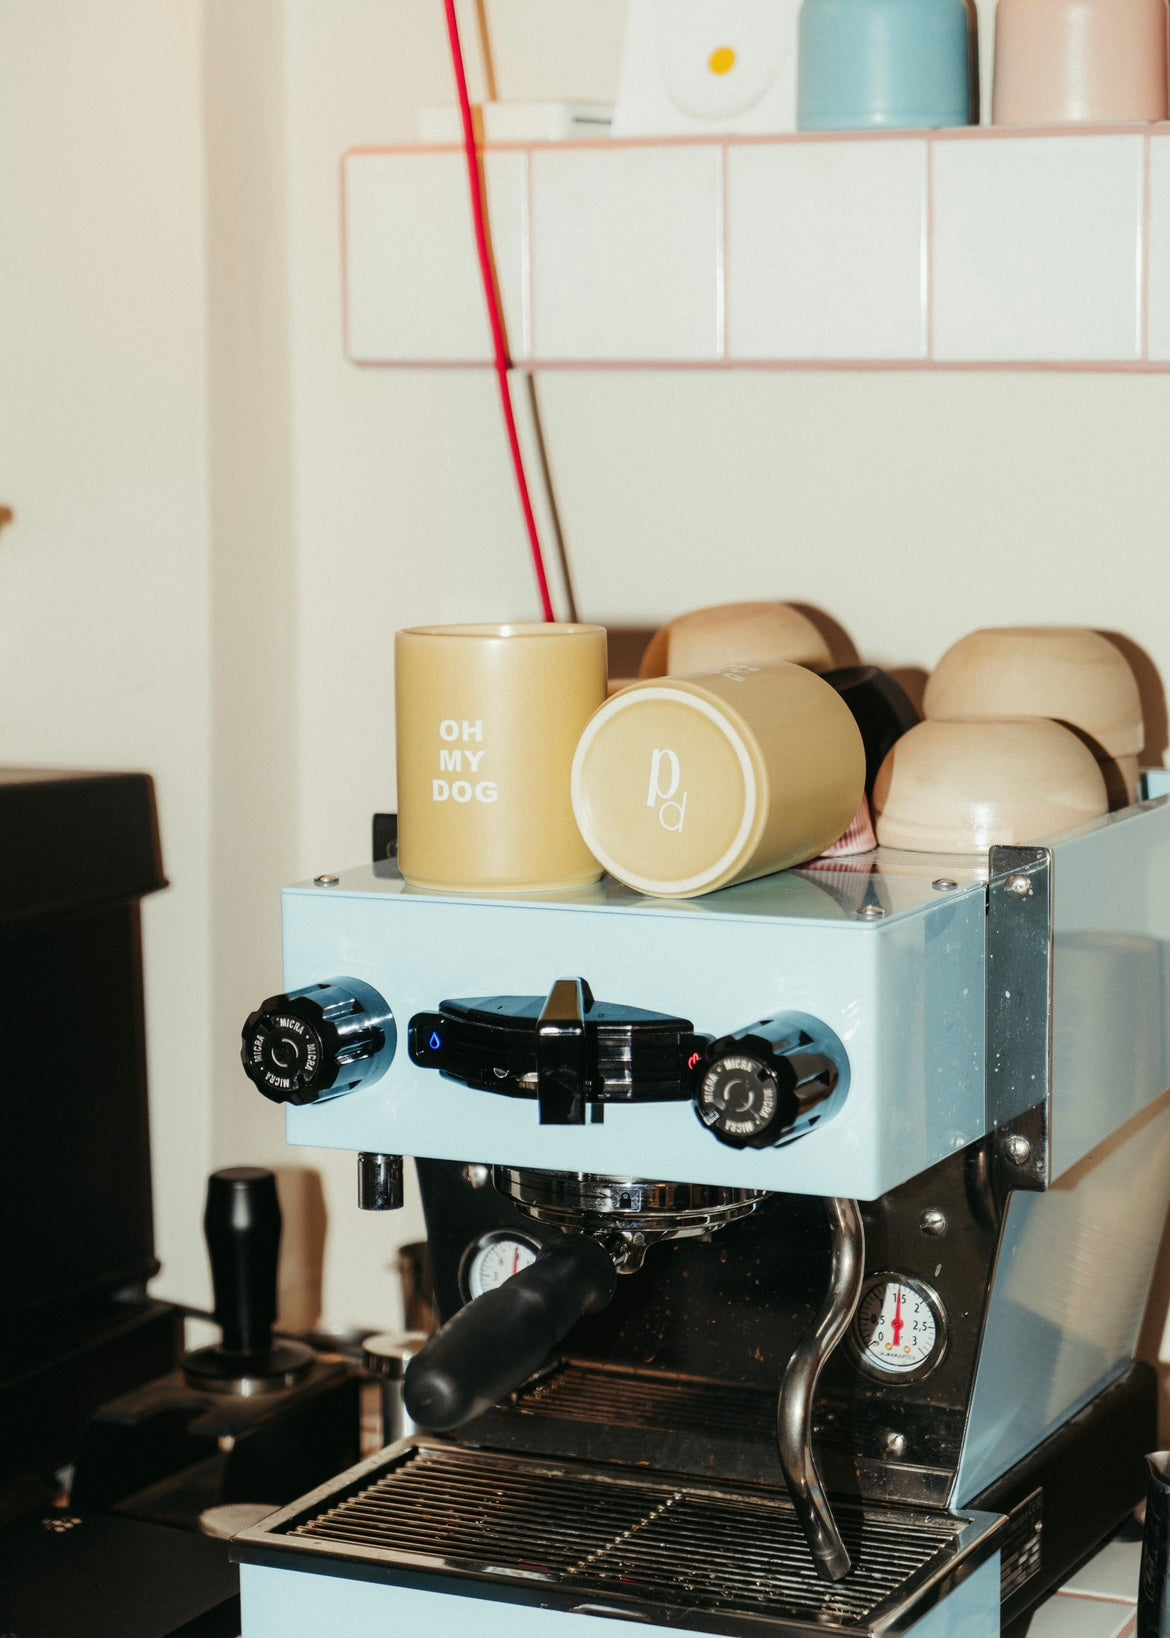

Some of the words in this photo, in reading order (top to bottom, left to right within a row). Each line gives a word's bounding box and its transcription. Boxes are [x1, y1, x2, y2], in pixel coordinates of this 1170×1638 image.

[439, 719, 483, 741] OH
[439, 750, 486, 772] MY
[432, 779, 499, 803] DOG
[279, 1017, 305, 1035] MICRA
[253, 1034, 265, 1063] MICRA
[305, 1043, 317, 1071] MICRA
[723, 1058, 752, 1073] MICRA
[265, 1071, 290, 1088] MICRA
[703, 1072, 719, 1104] MICRA
[760, 1088, 774, 1119] MICRA
[724, 1119, 755, 1134] MICRA
[914, 1303, 920, 1313] 2
[913, 1320, 928, 1332] 2,5
[878, 1331, 884, 1341] 0
[912, 1335, 917, 1346] 3
